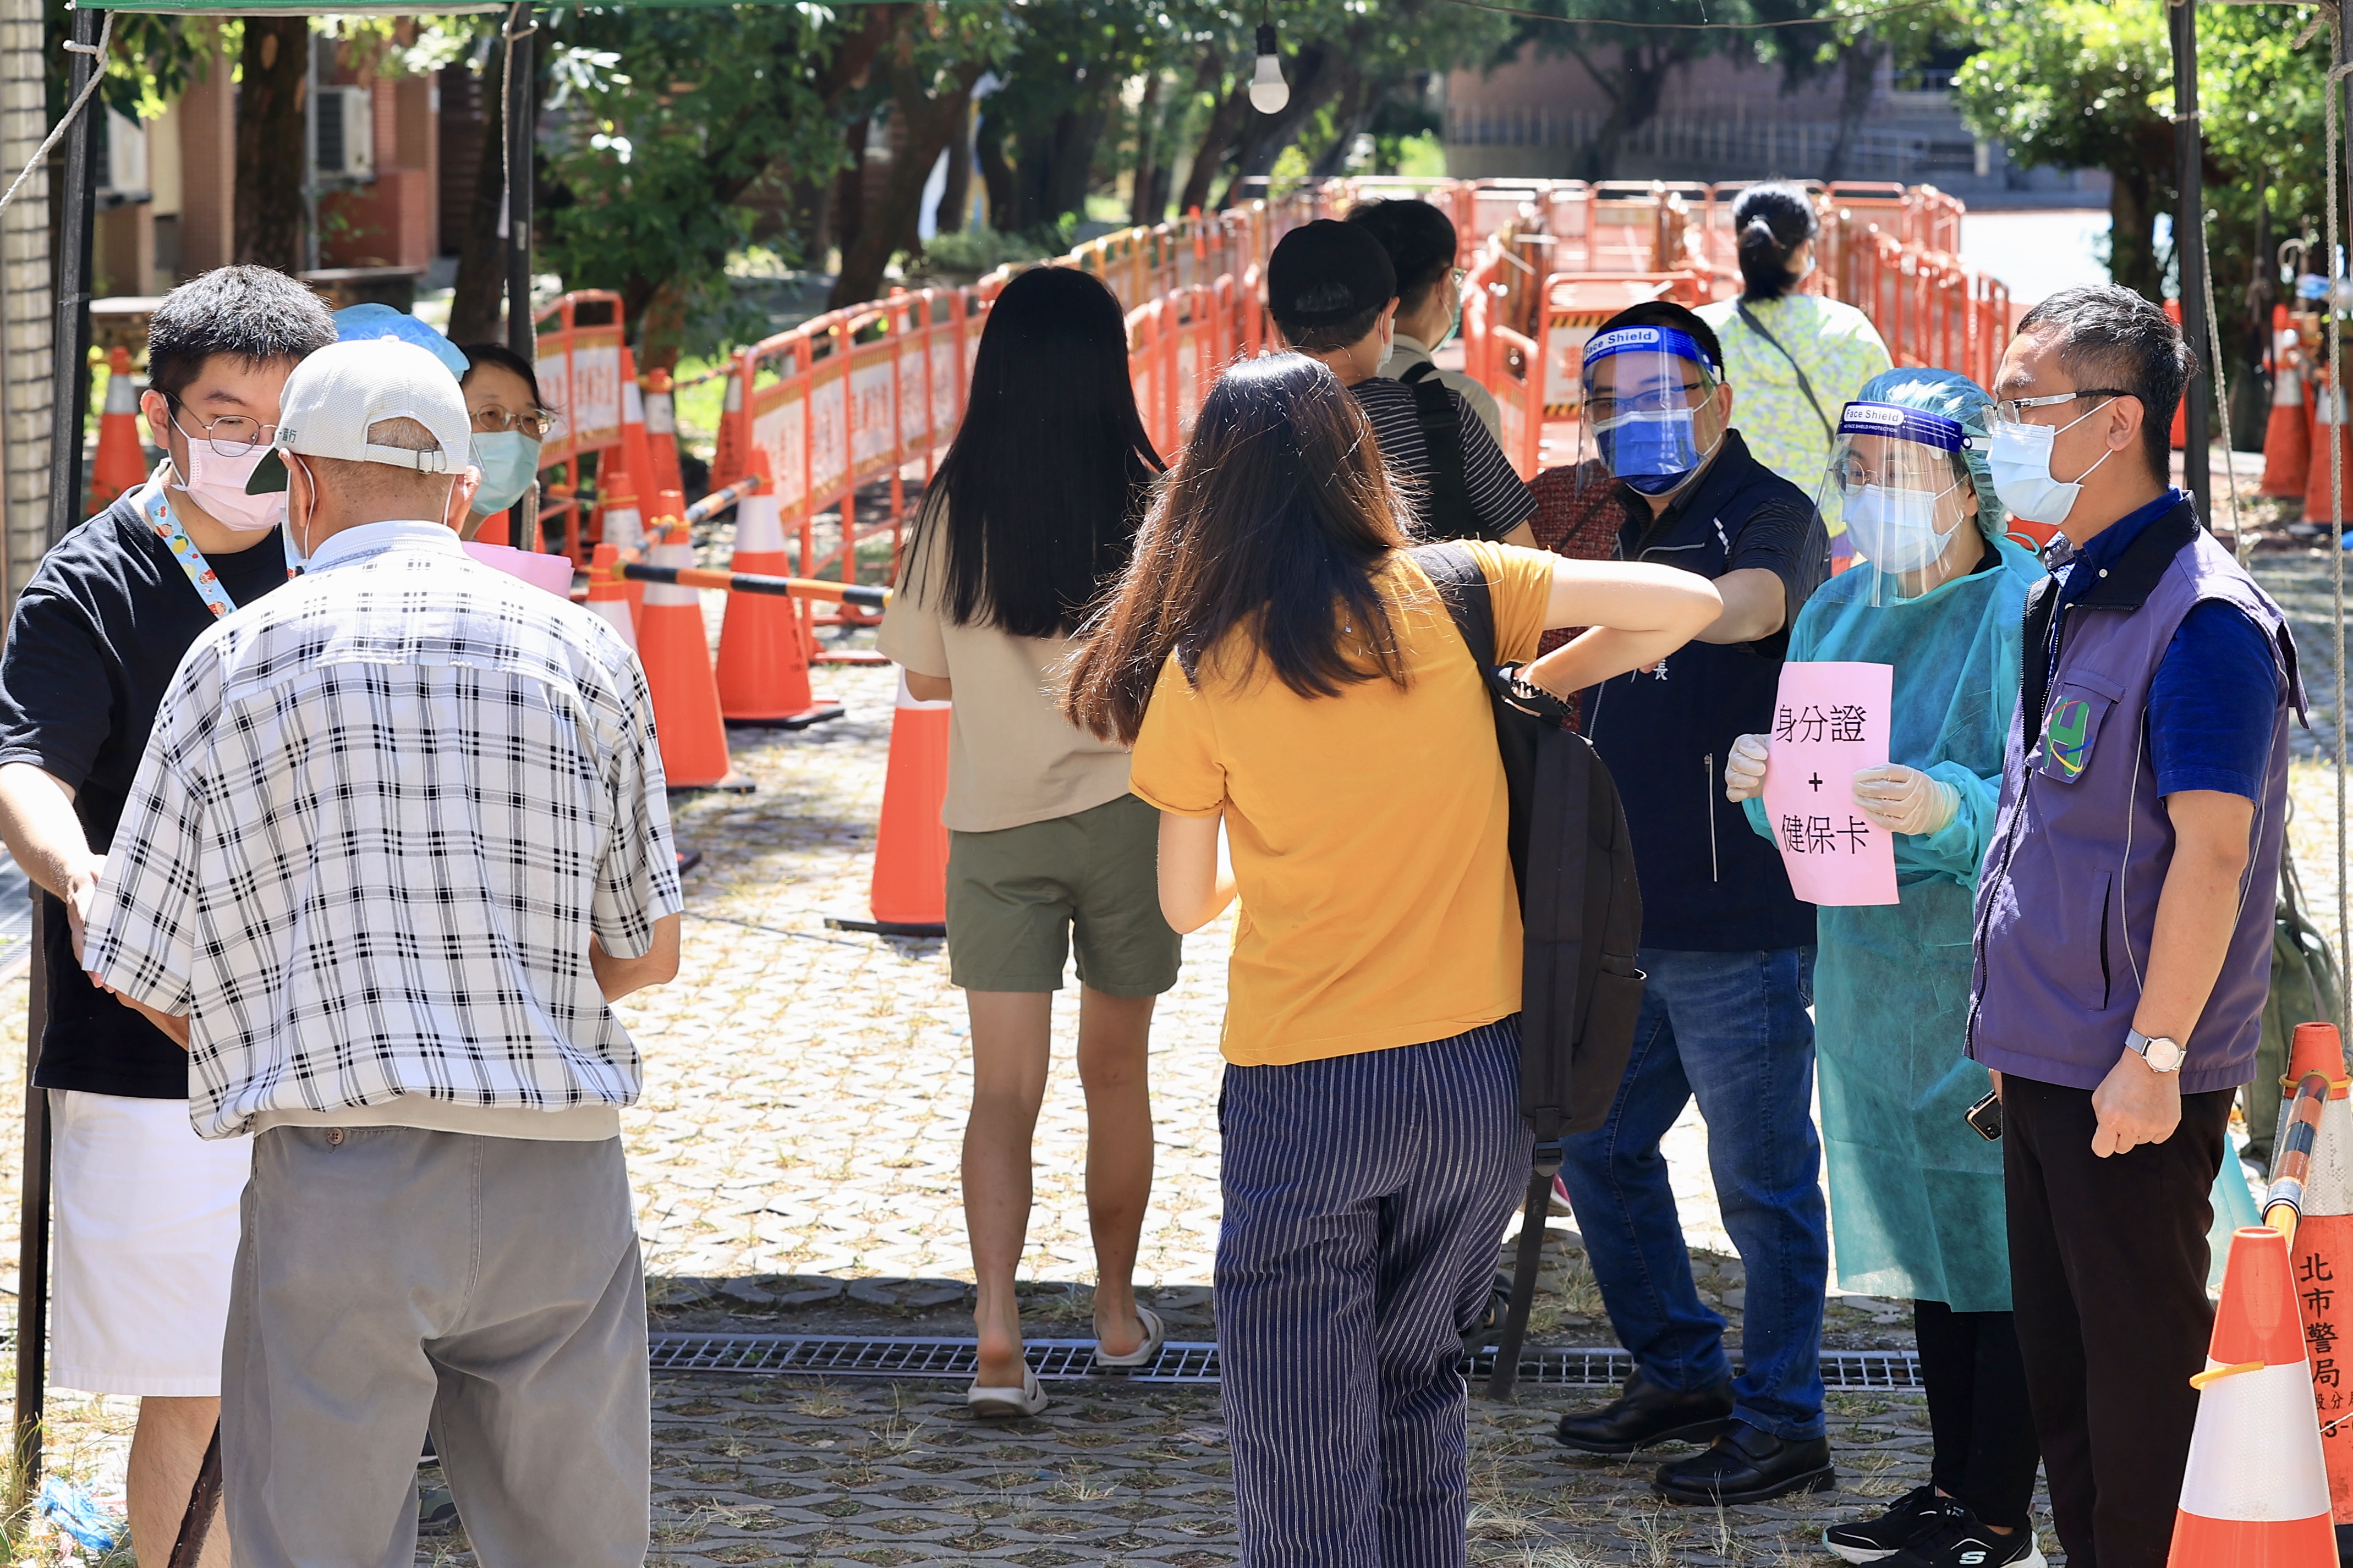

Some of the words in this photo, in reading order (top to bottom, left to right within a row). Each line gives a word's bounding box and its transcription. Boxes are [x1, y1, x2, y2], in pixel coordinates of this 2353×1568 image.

[1586, 340, 1604, 356] Face
[1608, 331, 1652, 344] Shield
[1846, 409, 1863, 418] Face
[1865, 410, 1899, 422] Shield
[1775, 704, 1867, 743] 身分證
[1780, 814, 1869, 855] 健保卡
[2299, 1253, 2340, 1388] 北市警局
